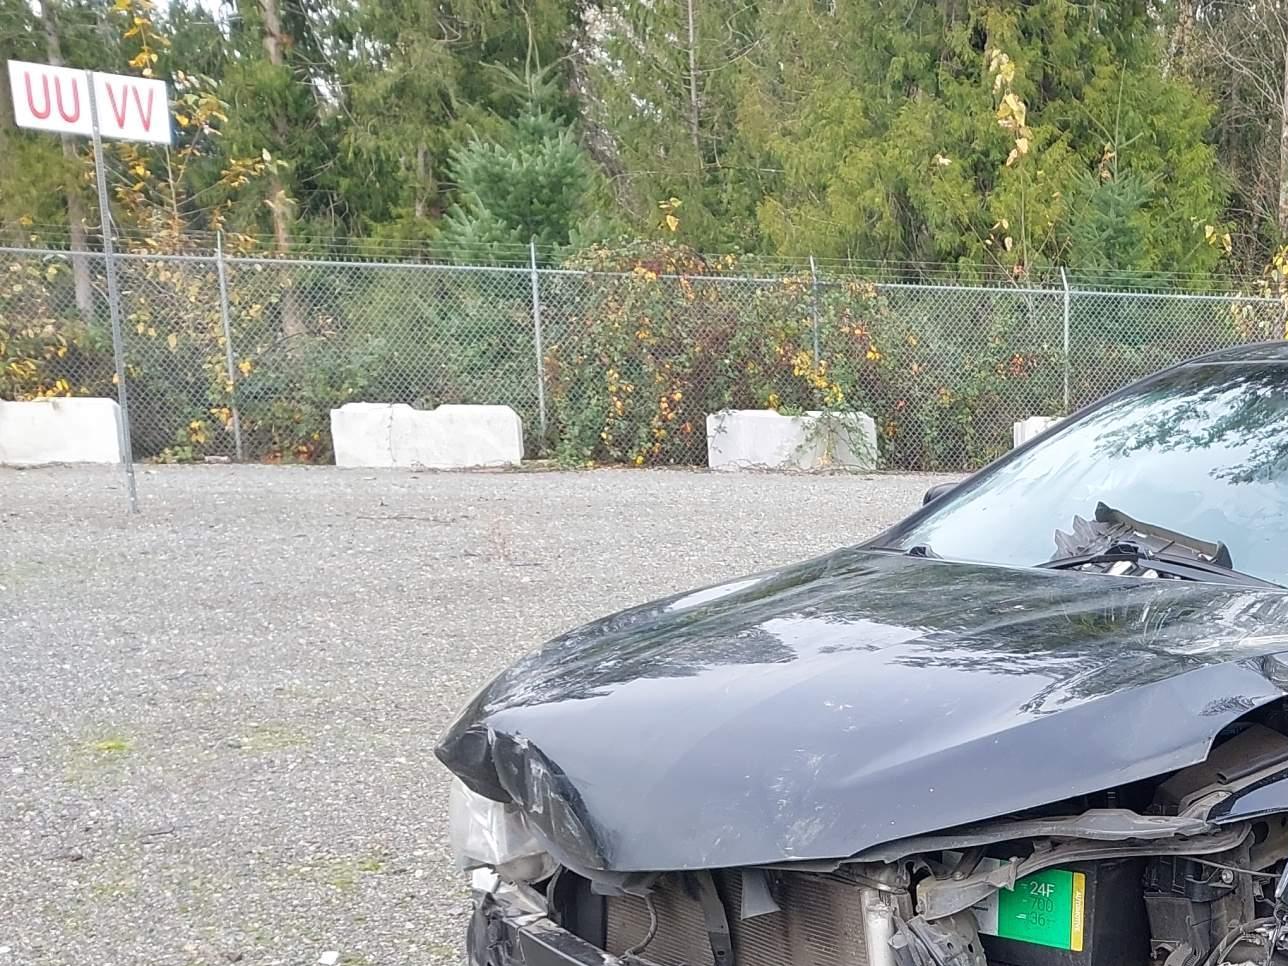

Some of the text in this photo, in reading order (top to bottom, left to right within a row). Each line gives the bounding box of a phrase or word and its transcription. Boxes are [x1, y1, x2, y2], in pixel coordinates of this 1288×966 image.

[25, 71, 154, 132] UU VV
[1030, 881, 1055, 897] 24F
[1031, 898, 1054, 913] 700
